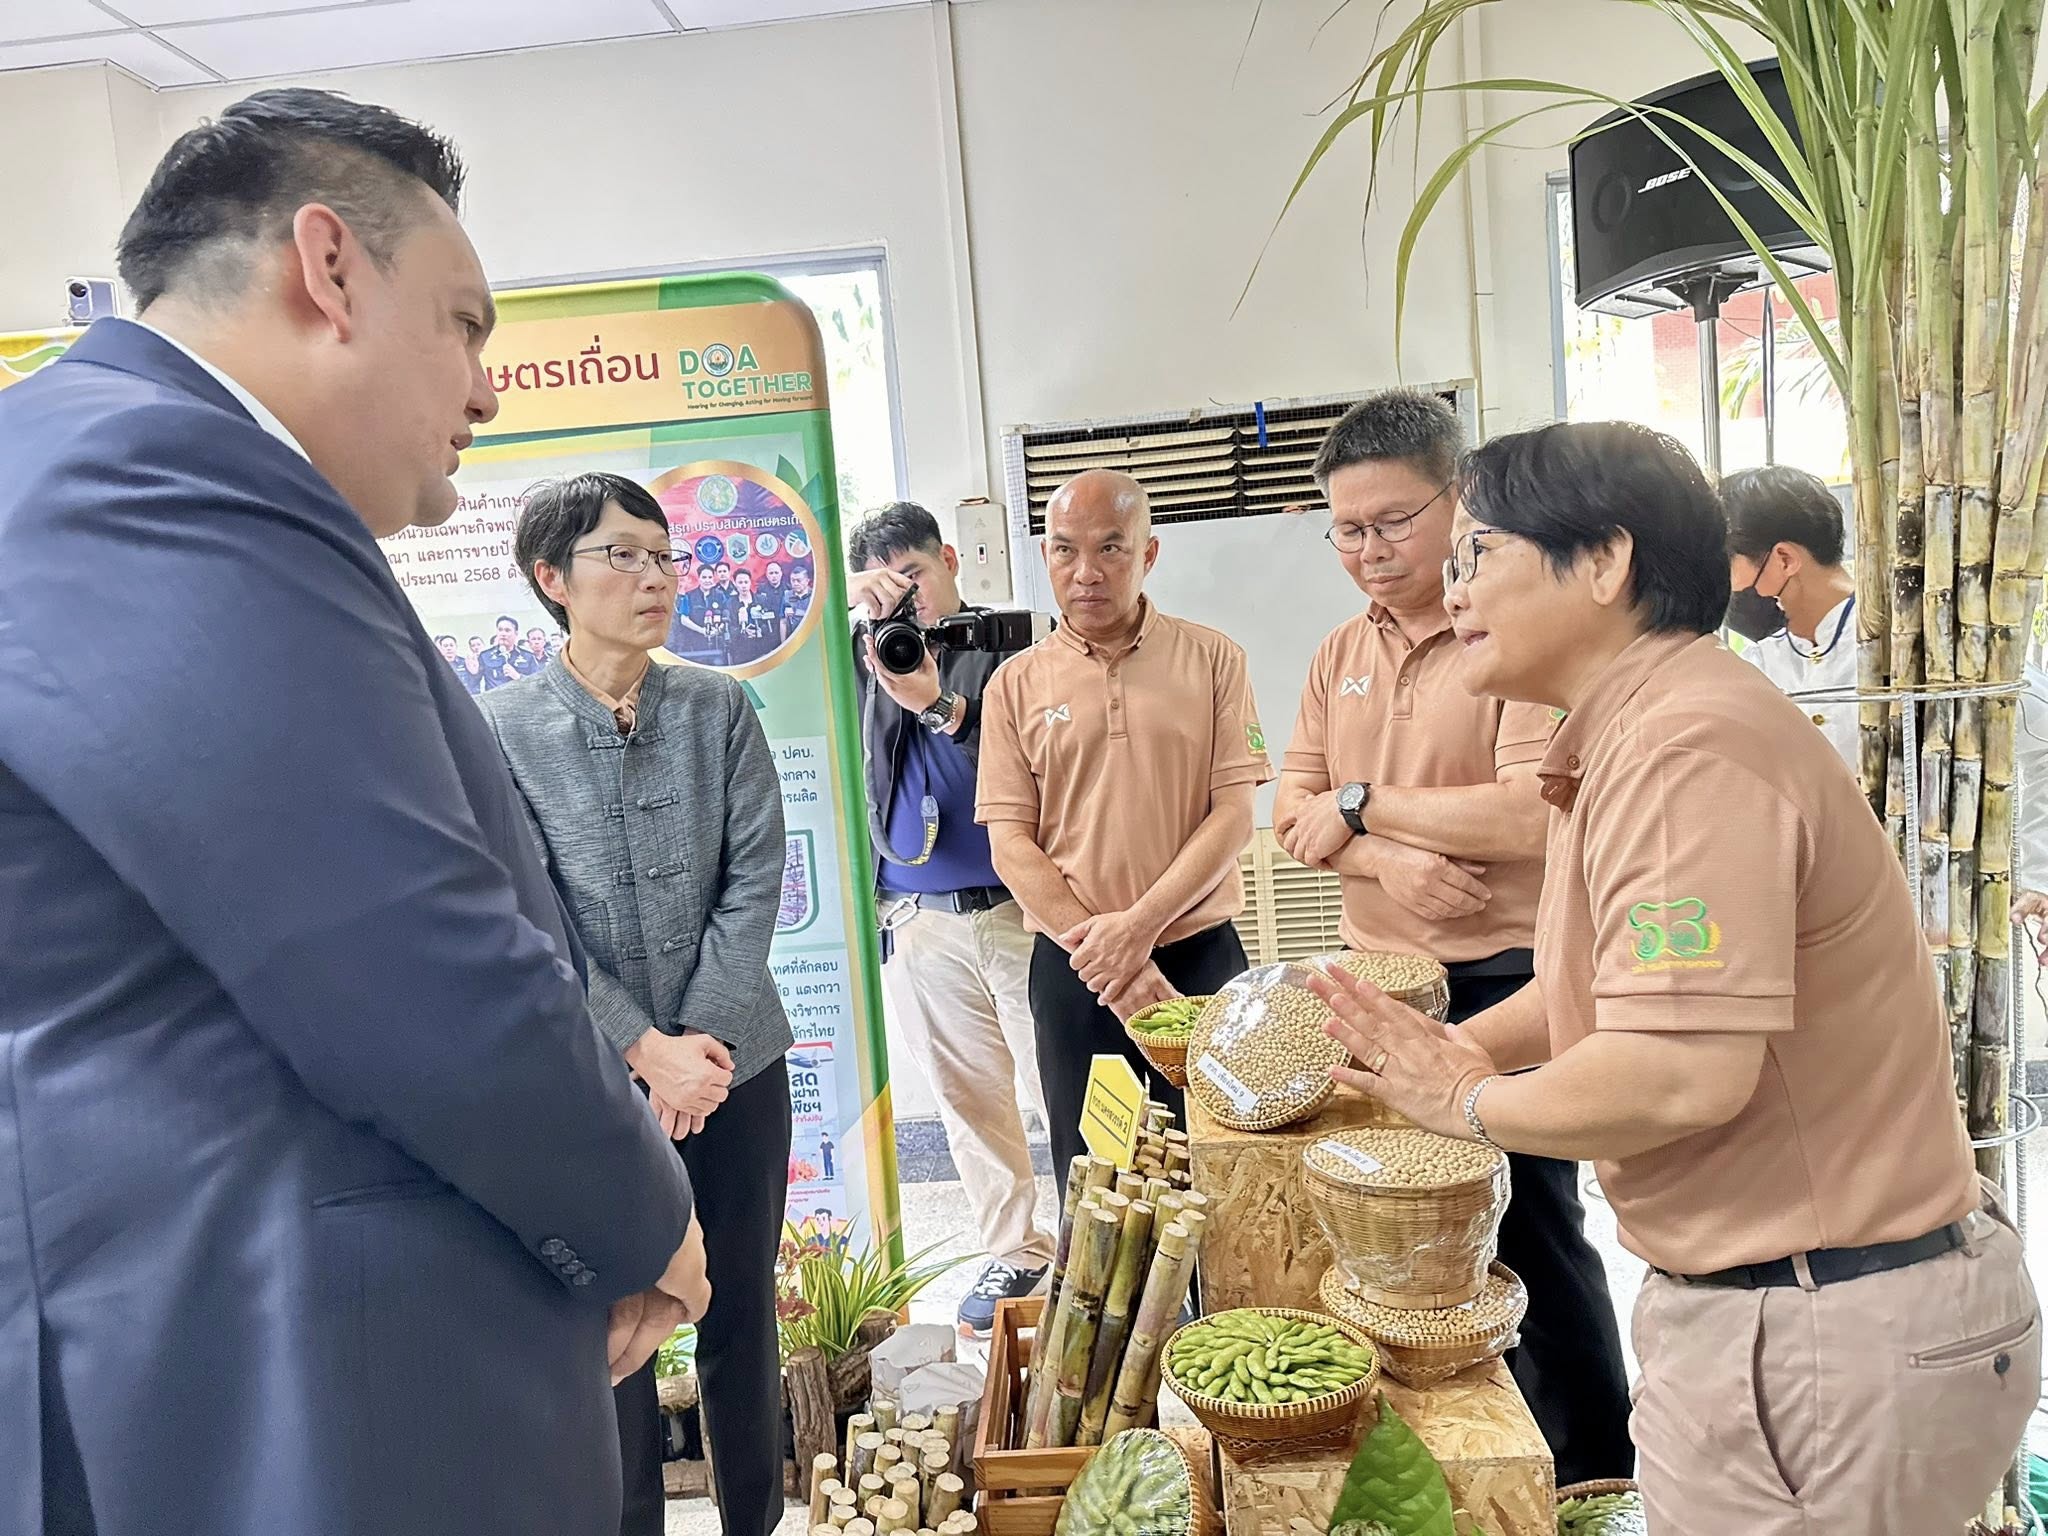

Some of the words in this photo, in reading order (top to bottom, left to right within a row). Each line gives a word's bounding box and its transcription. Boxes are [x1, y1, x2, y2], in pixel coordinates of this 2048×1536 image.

[1637, 167, 1692, 194] BOSE
[486, 335, 660, 393] ษตรเถื่อน
[682, 372, 812, 399] TOGETHER
[397, 571, 458, 588] ประมาณ
[464, 567, 500, 582] 2568
[782, 745, 814, 760] ปคบ.
[796, 982, 841, 996] แตงกวา
